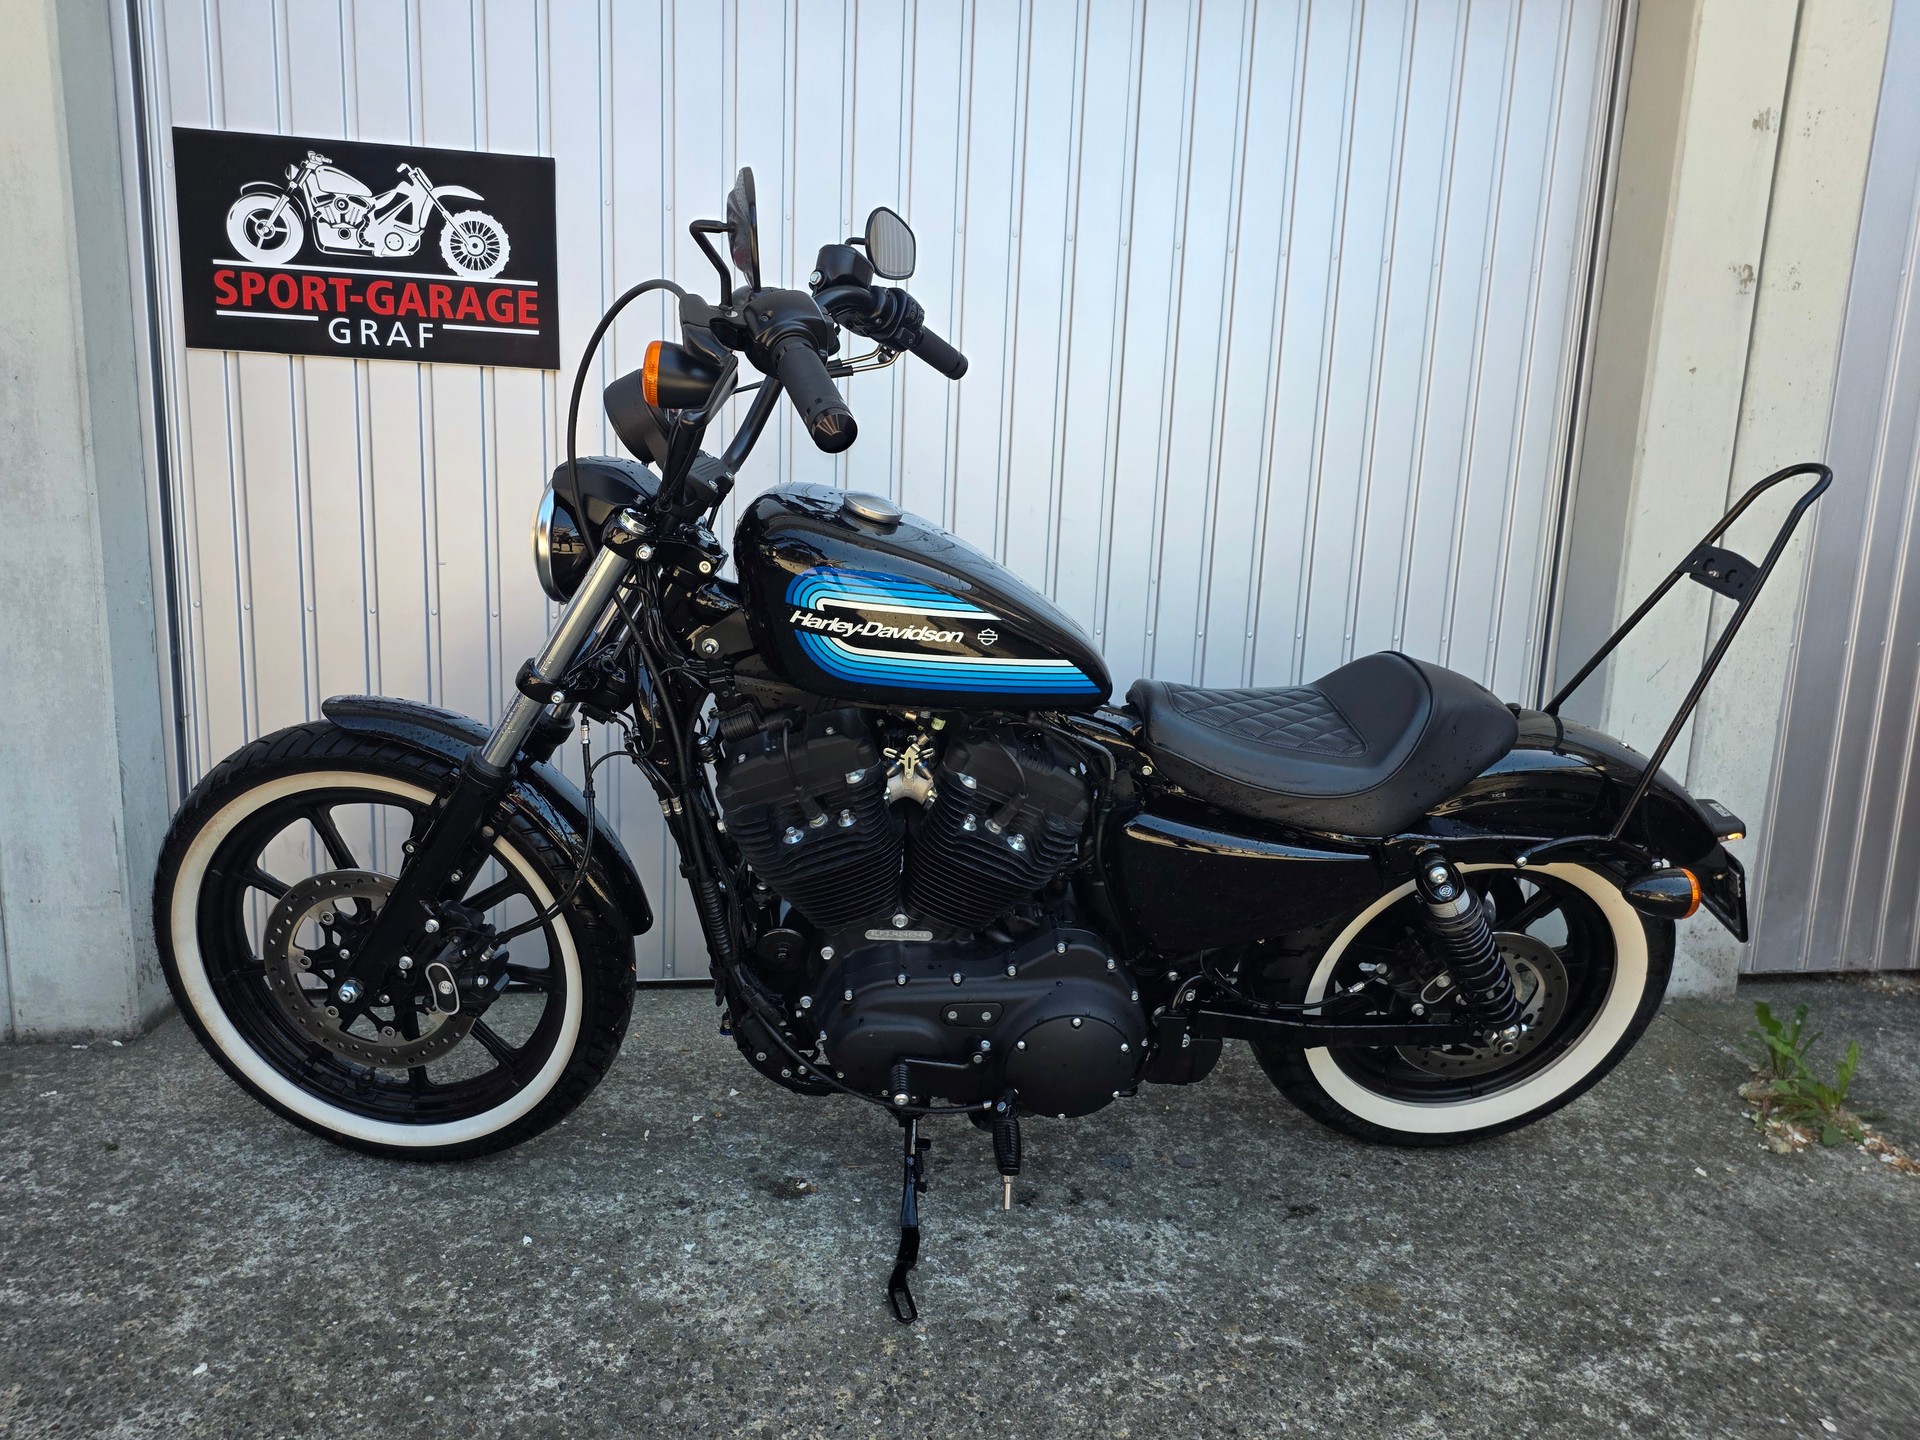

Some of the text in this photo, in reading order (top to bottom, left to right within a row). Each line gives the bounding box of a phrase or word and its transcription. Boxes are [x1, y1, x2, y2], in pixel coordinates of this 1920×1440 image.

[213, 270, 540, 325] SPORT-GARAGE
[328, 317, 434, 348] GRAF
[789, 610, 965, 643] Harley-Davidson
